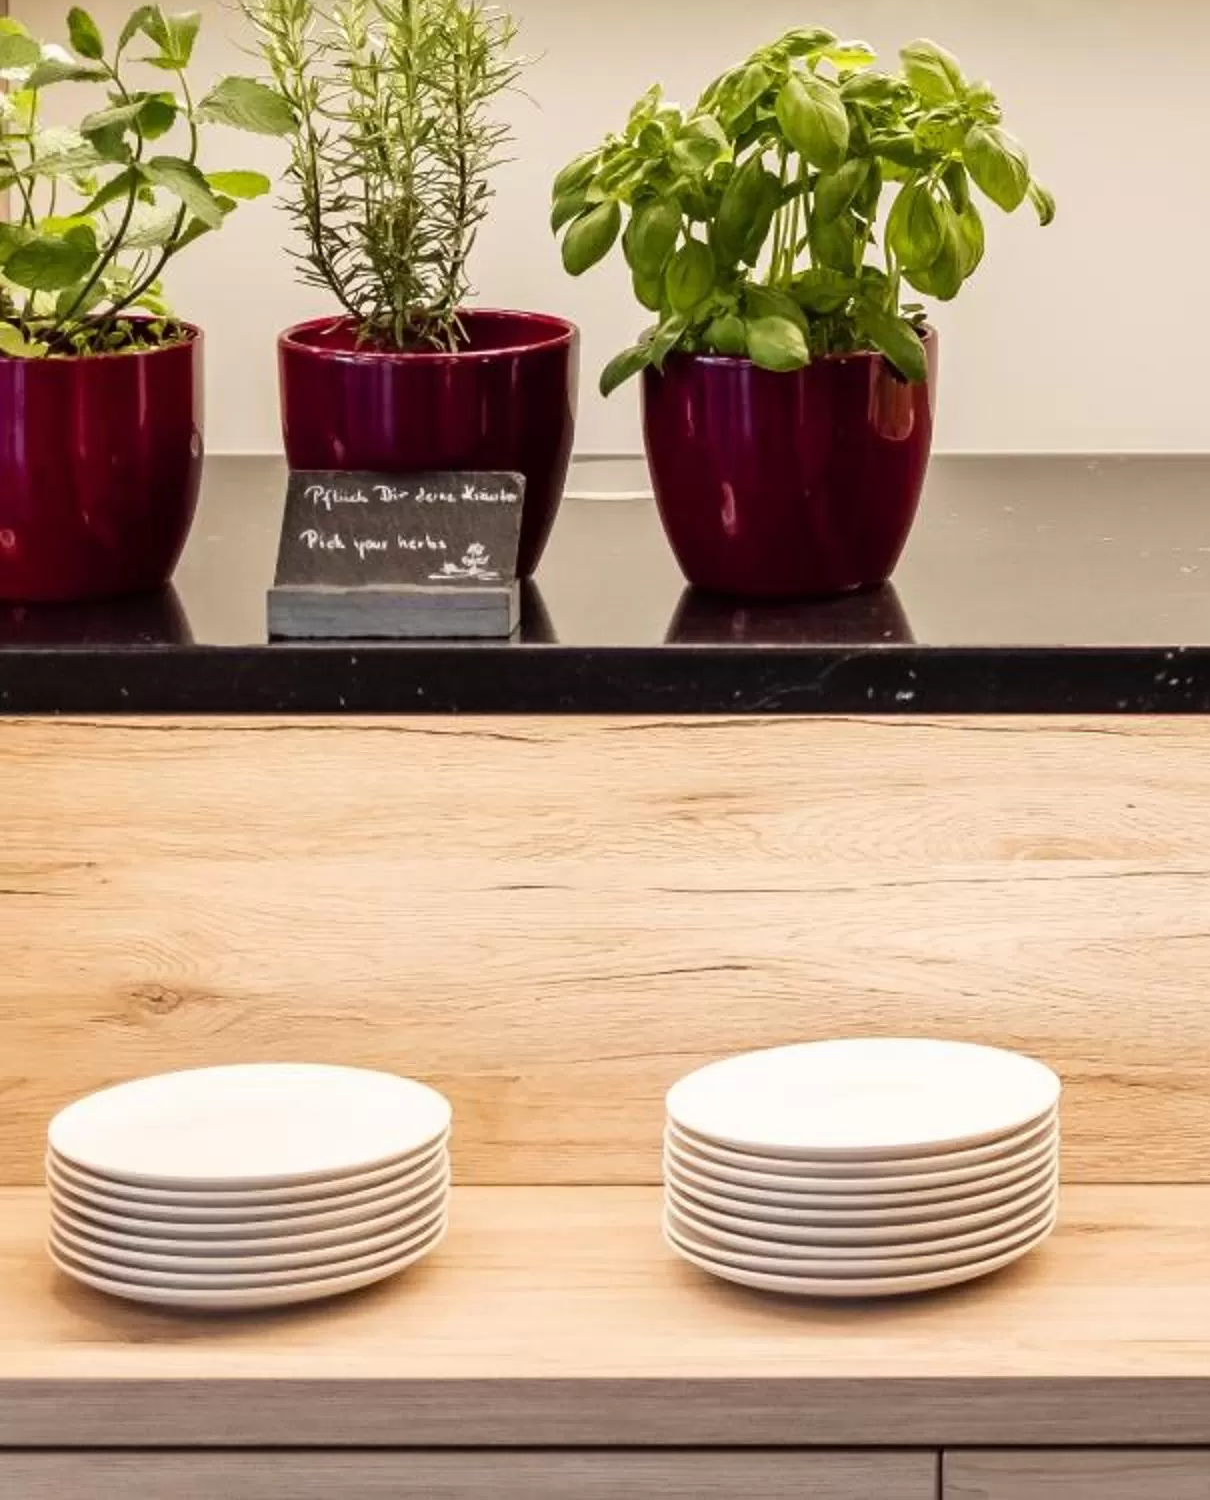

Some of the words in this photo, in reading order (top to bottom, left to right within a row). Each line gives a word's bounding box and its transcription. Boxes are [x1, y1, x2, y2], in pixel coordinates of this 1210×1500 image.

[372, 485, 409, 503] Dir
[299, 529, 346, 549] Pick
[353, 538, 388, 560] your
[397, 531, 447, 550] herbs
